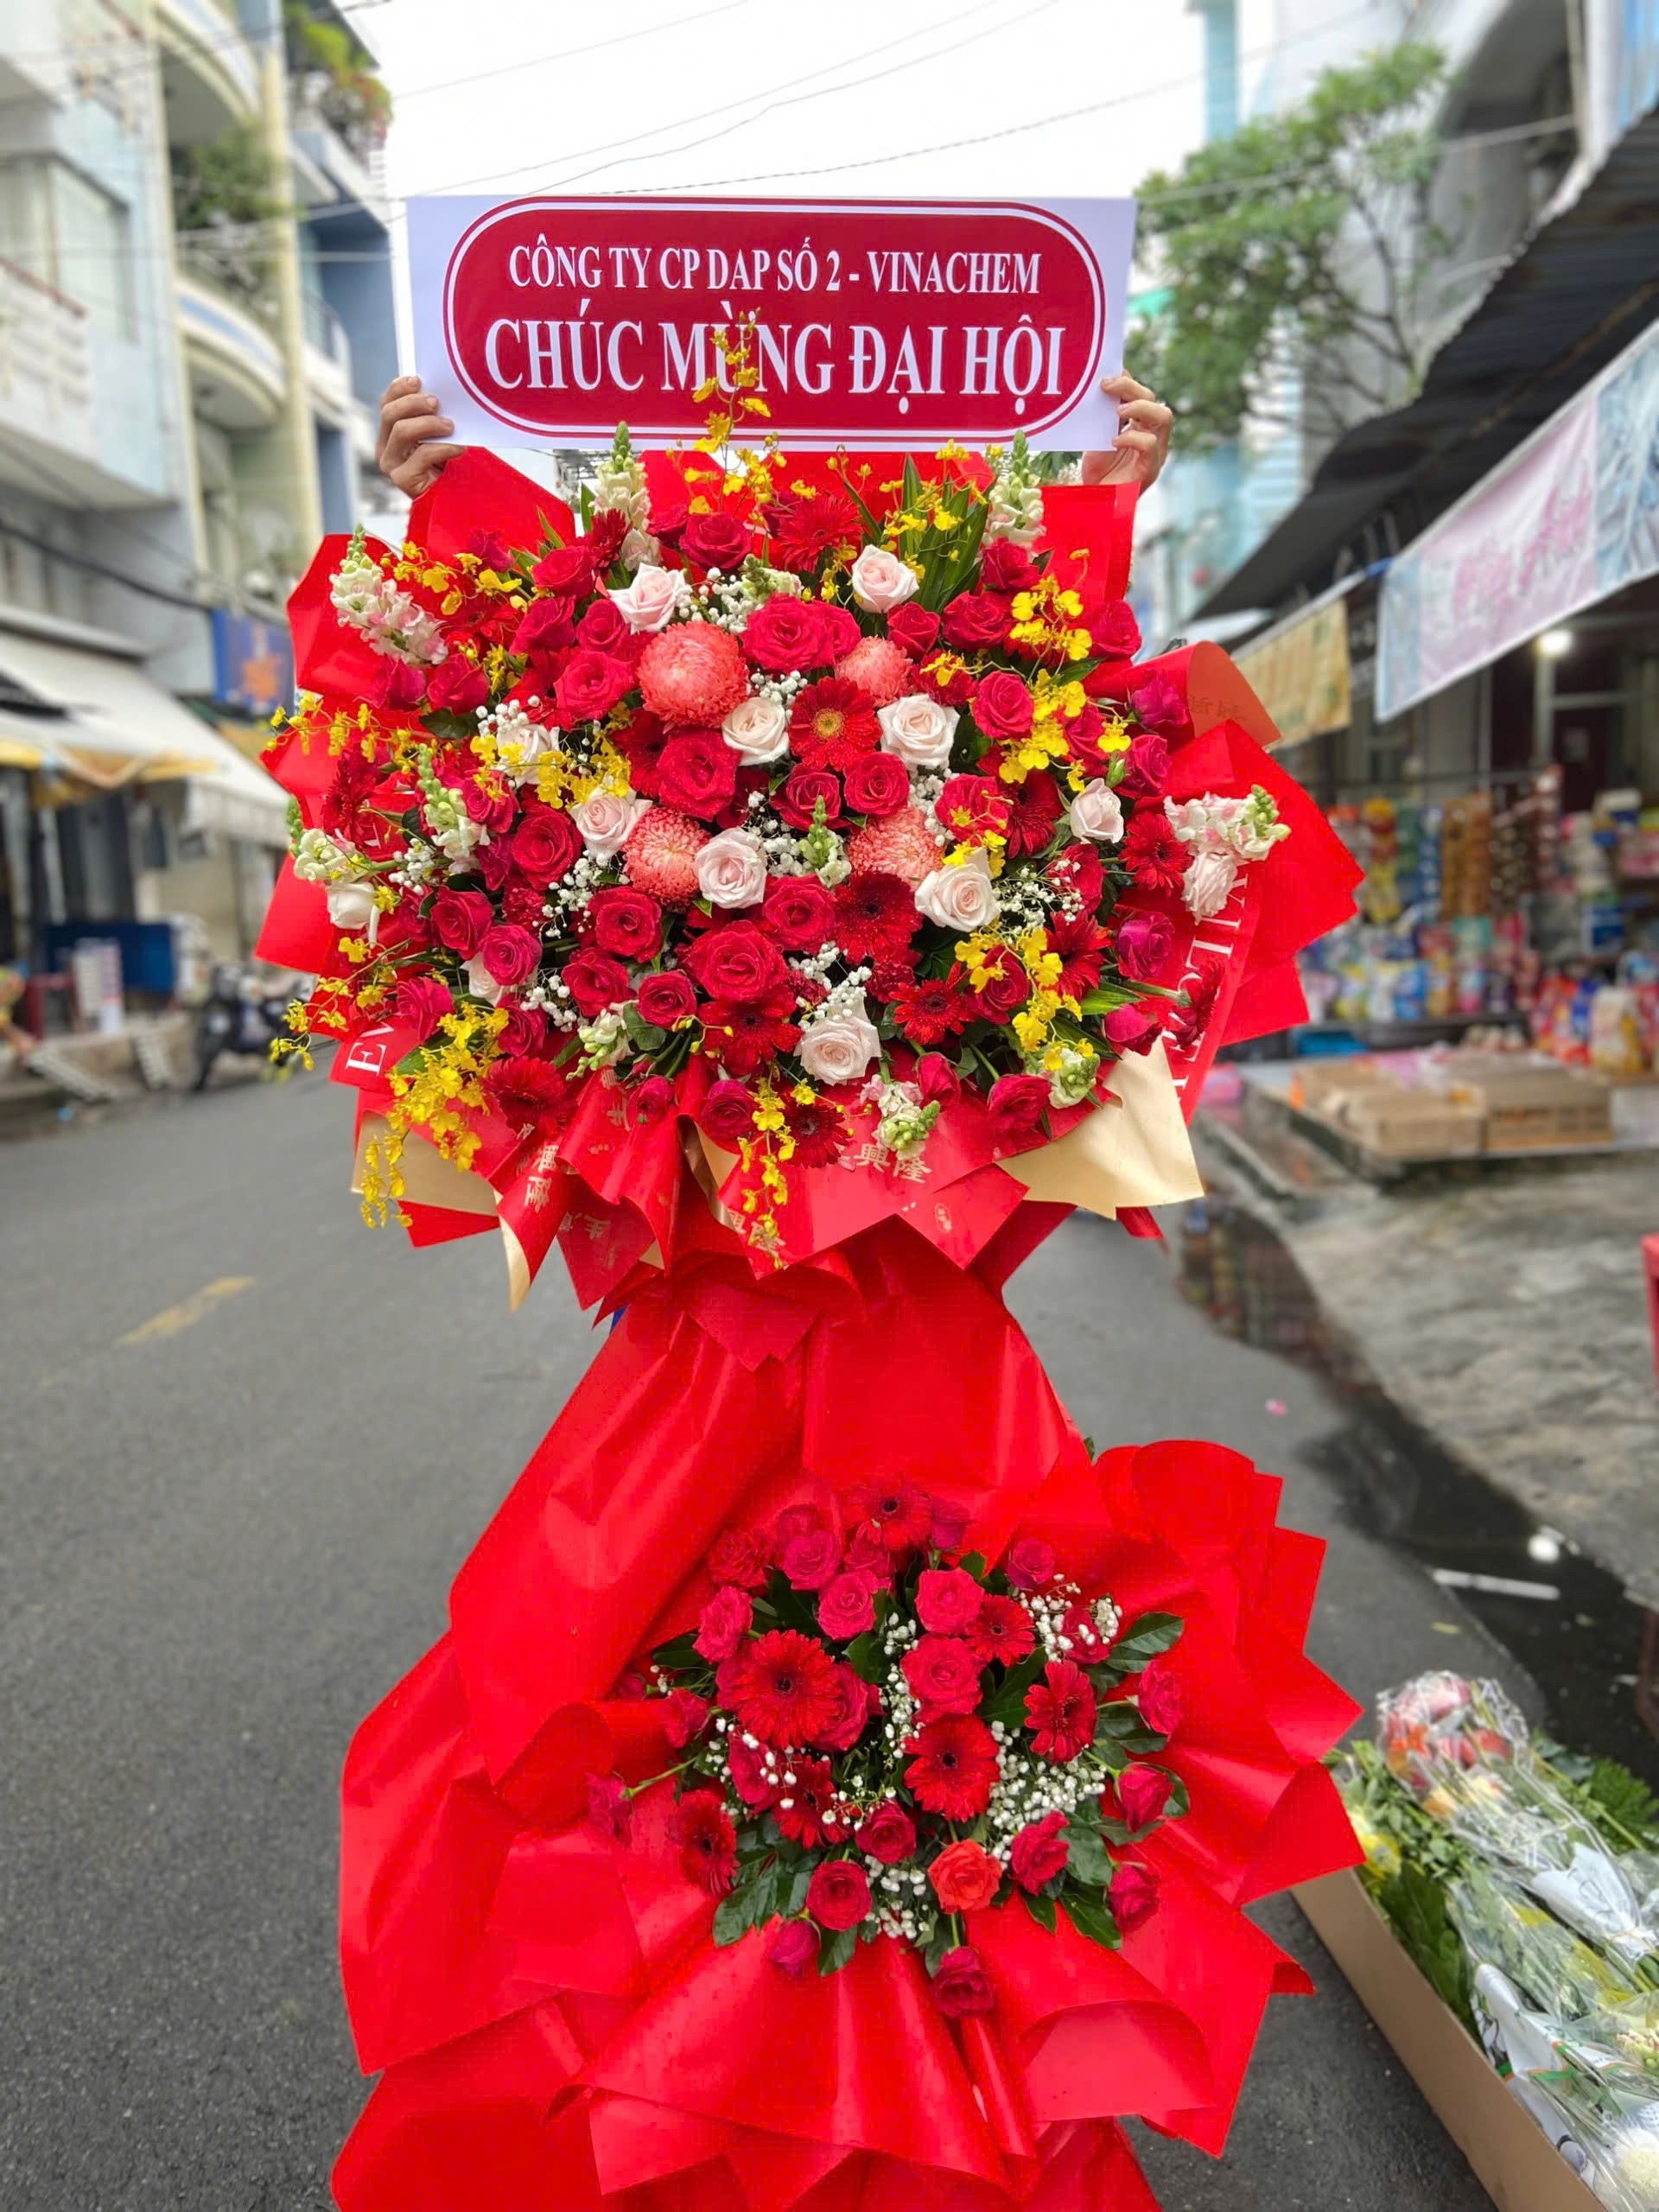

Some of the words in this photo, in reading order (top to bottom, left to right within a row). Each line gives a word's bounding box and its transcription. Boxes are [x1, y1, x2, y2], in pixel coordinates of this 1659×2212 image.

[509, 232, 603, 288] CÔNG
[608, 247, 652, 289] TY
[658, 247, 701, 289] CP
[706, 249, 771, 290] DAP
[777, 236, 818, 291] SỐ
[825, 250, 842, 291] 2
[867, 251, 1042, 294] VINACHEM
[485, 298, 645, 391] CHÚC
[658, 300, 836, 395] MỪNG
[848, 324, 949, 415] ĐẠI
[959, 314, 1066, 415] HỘI
